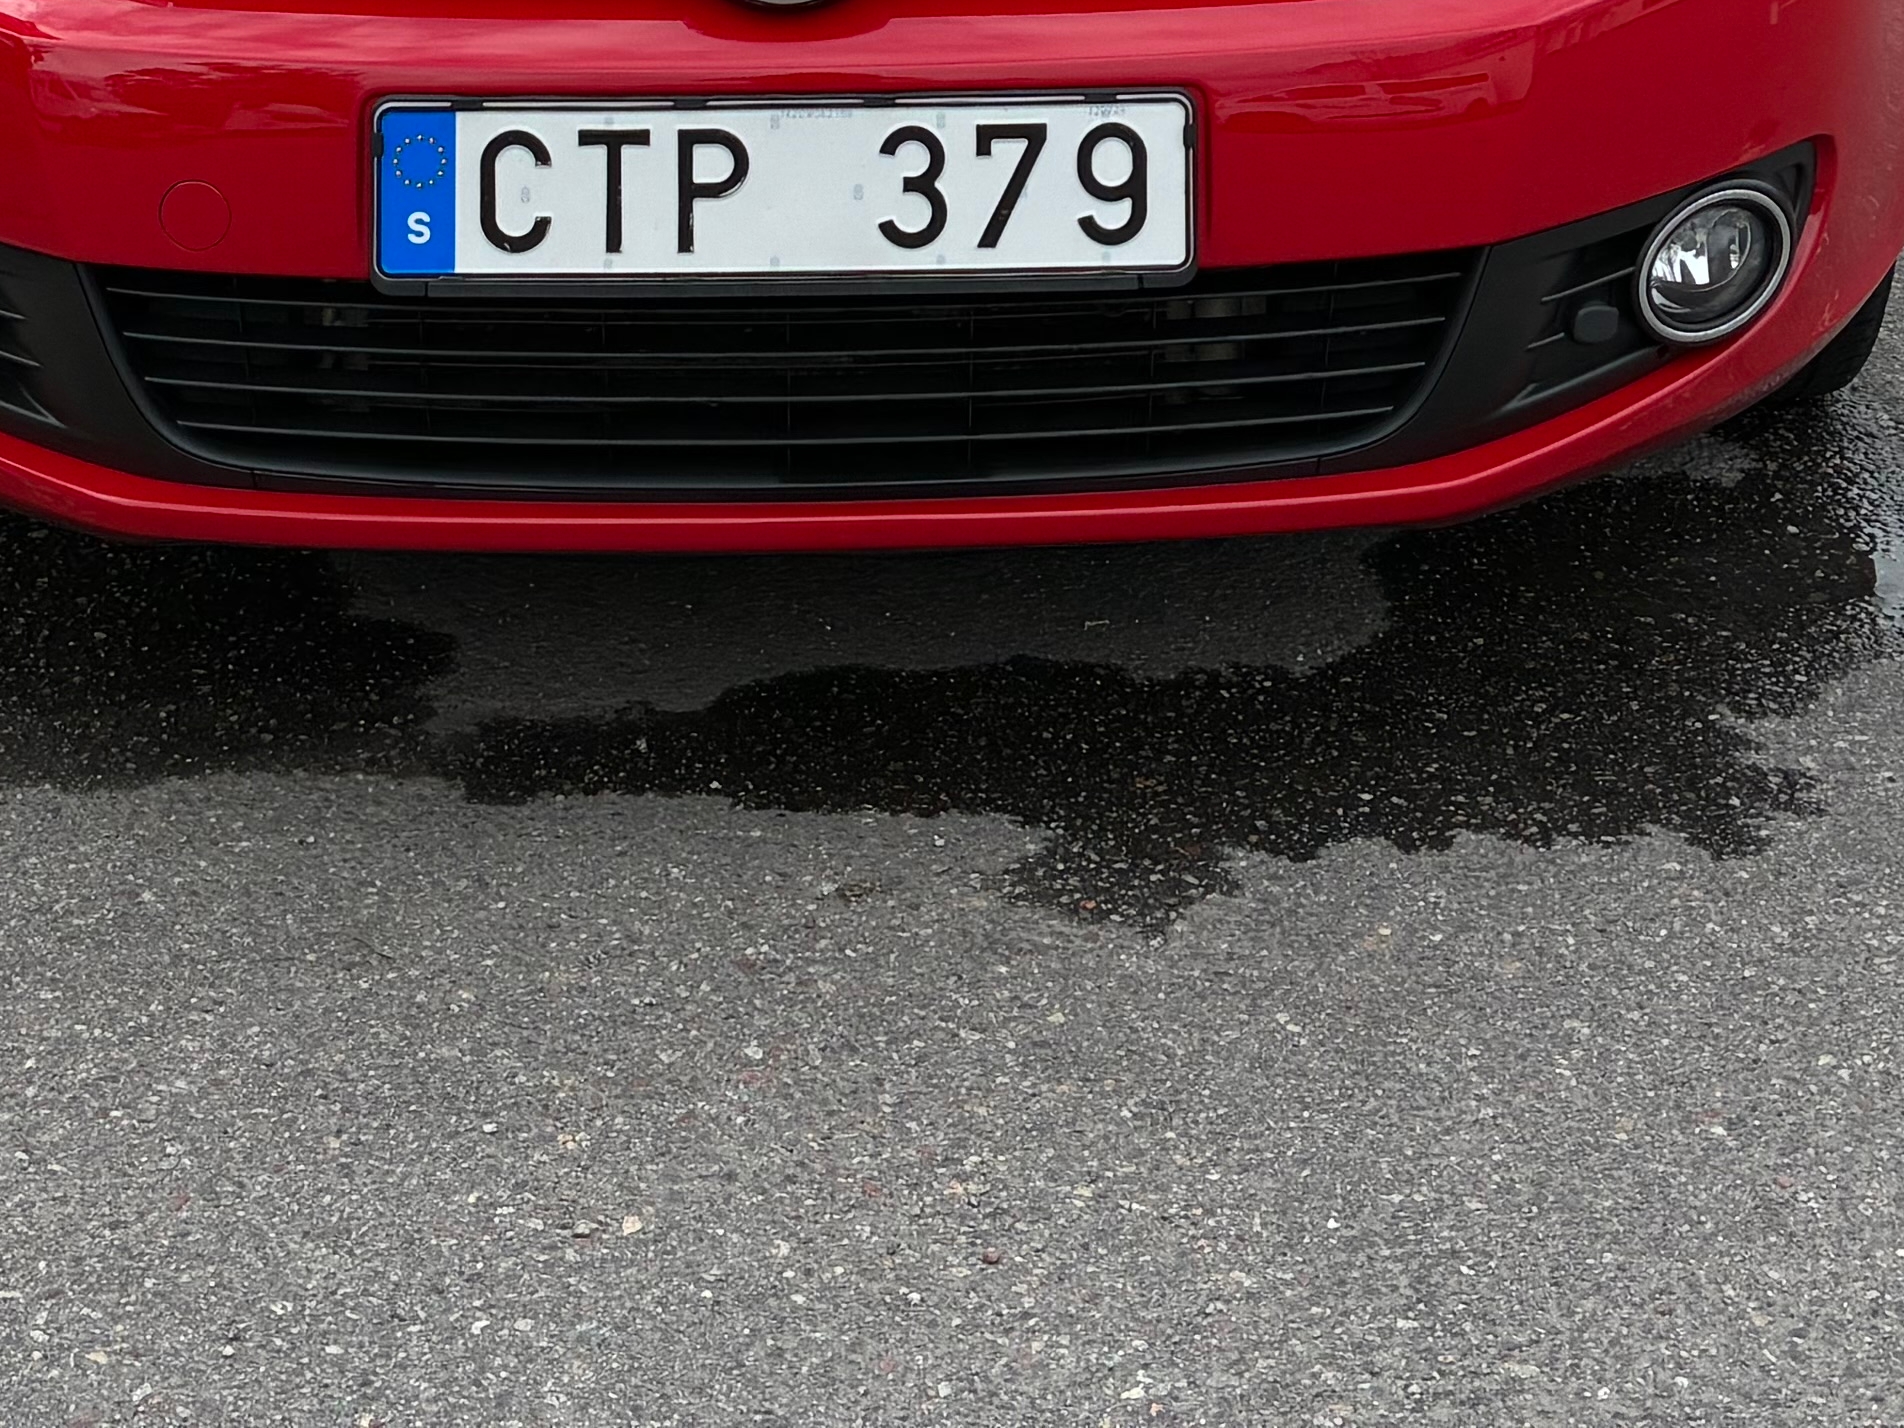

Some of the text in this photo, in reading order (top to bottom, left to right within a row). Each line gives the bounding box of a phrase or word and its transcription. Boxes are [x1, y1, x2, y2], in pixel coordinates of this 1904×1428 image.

[405, 211, 432, 246] S
[478, 122, 1149, 256] CTP 379
